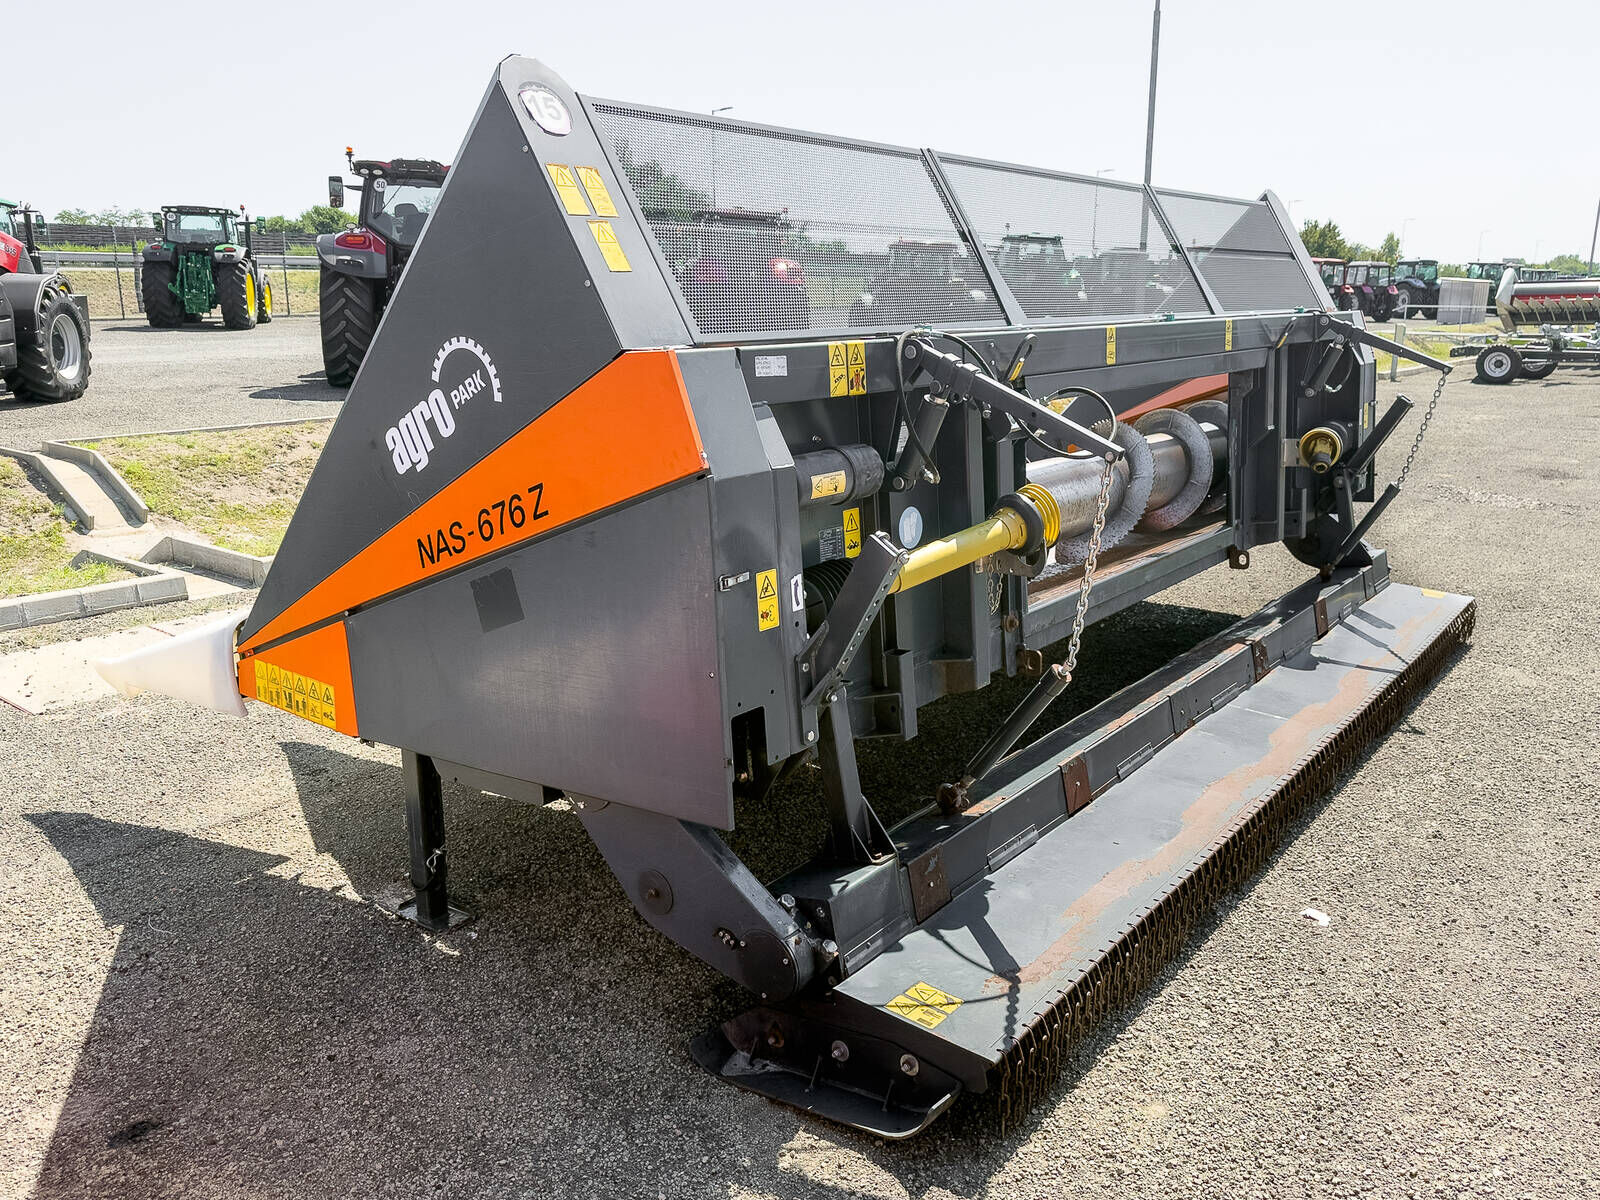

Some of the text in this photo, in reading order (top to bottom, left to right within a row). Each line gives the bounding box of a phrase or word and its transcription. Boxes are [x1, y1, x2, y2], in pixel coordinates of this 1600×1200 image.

[528, 94, 562, 121] 15
[385, 369, 486, 475] agro PARK
